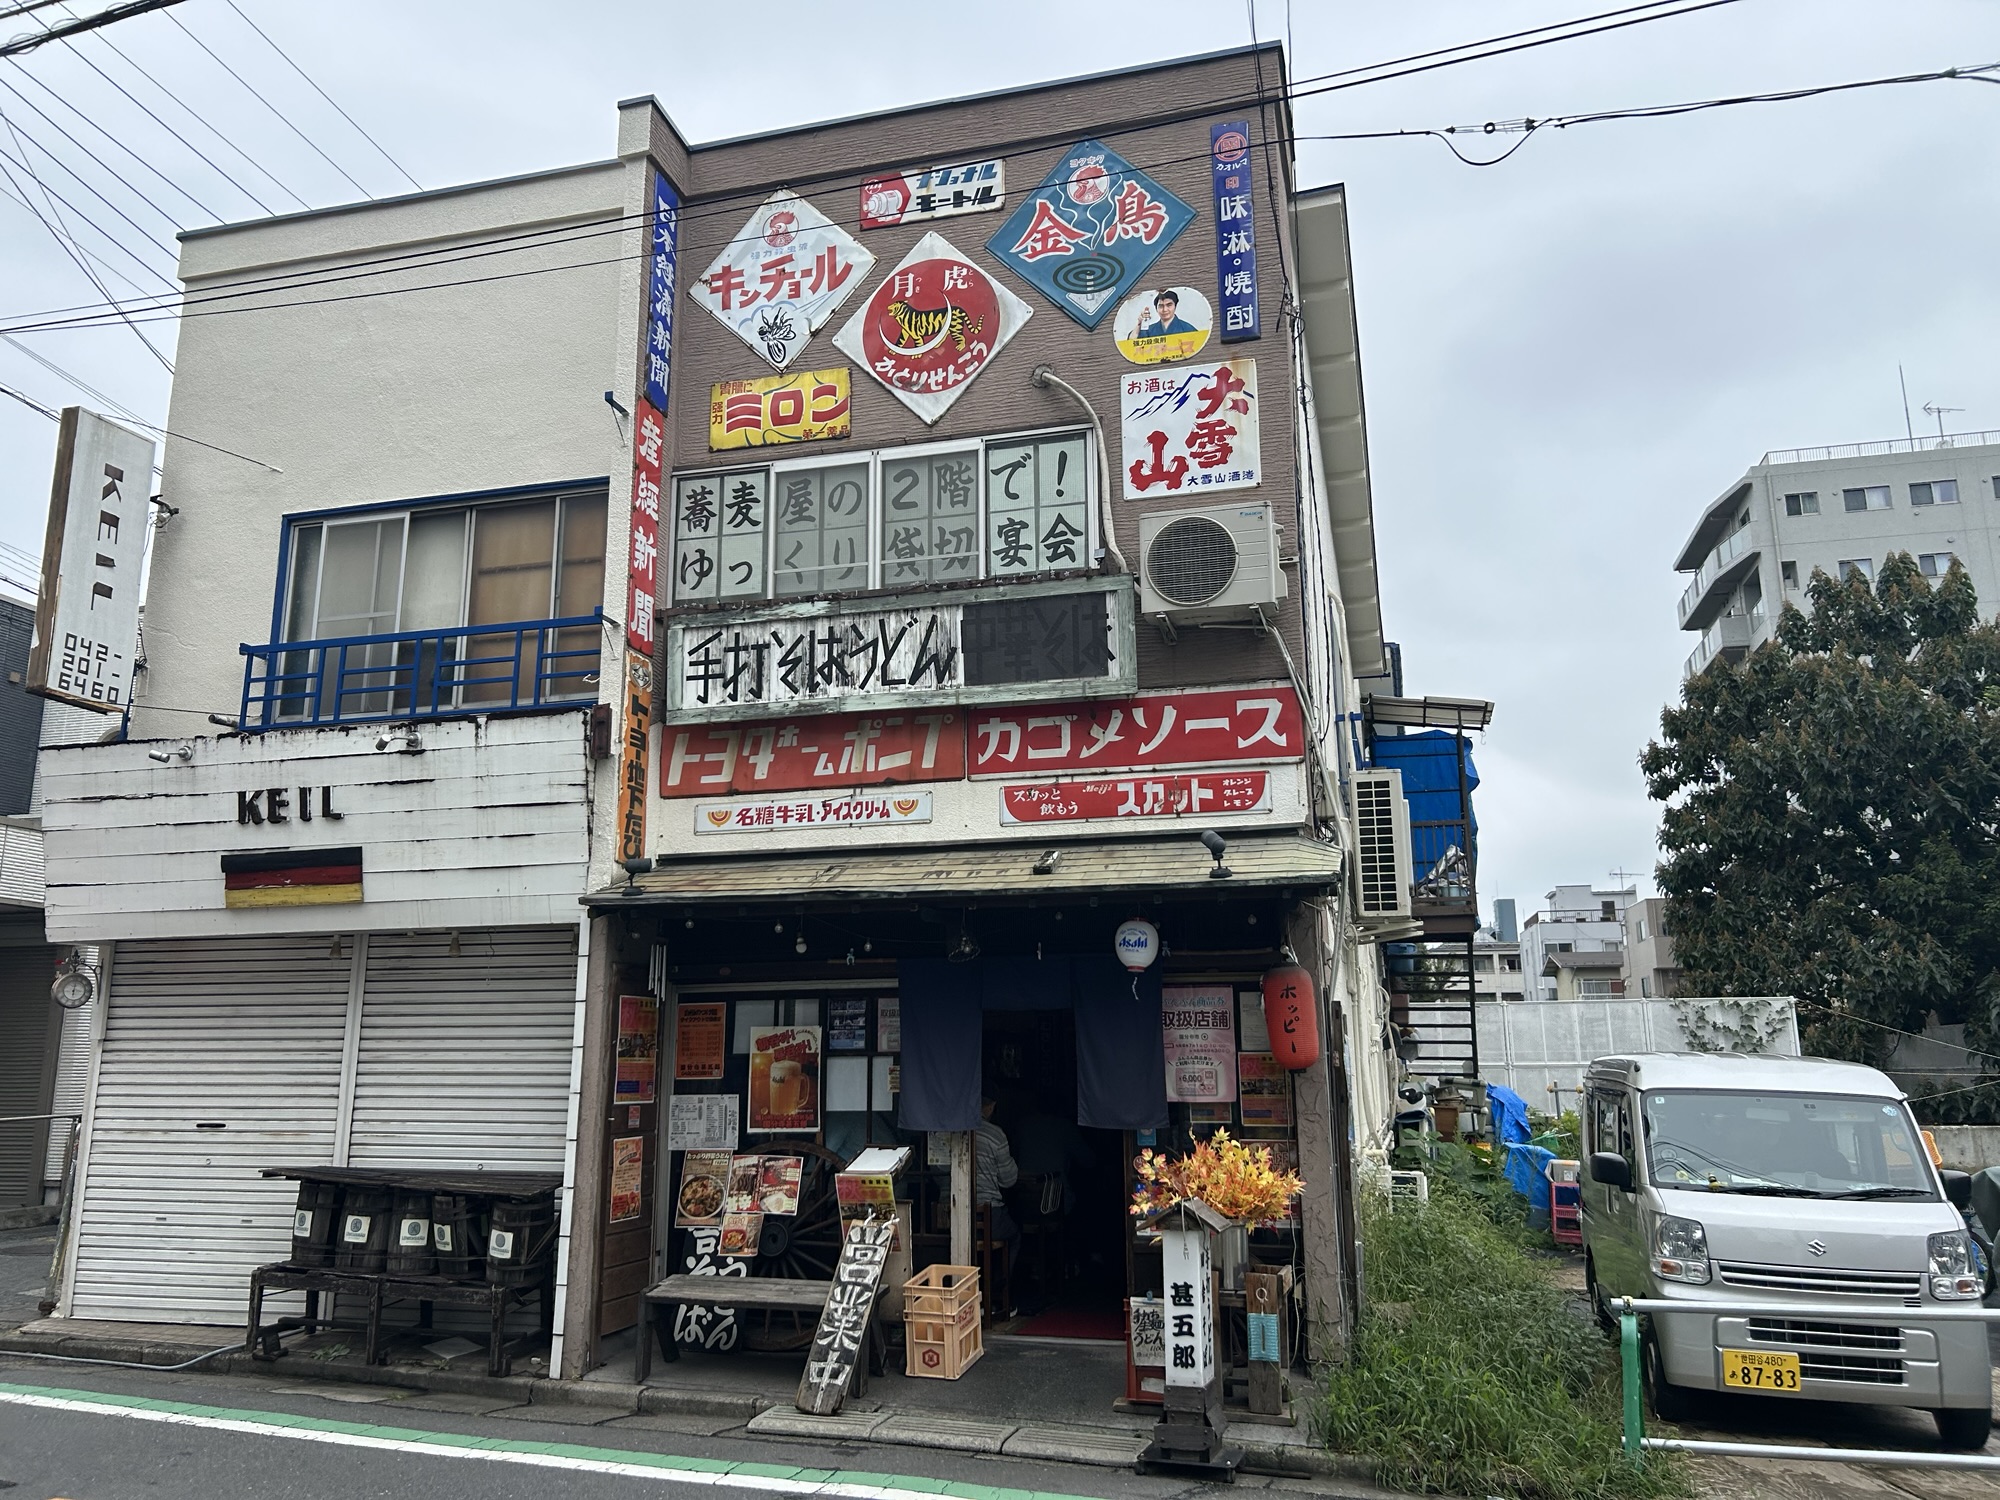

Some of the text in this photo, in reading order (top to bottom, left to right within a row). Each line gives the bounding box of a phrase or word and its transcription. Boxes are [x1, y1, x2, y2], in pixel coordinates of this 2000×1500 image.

[916, 163, 998, 189] ナショナル
[916, 185, 998, 213] モートル
[1009, 180, 1169, 262] 金鳥
[709, 244, 854, 311] キンチョール
[875, 340, 988, 391] かとりせんこう
[1127, 376, 1175, 395] お酒は
[725, 384, 849, 434] ミロン
[1187, 470, 1255, 486] 大雪山酒造
[91, 463, 124, 610] KEIL
[686, 614, 958, 704] 手打そばうどん
[58, 671, 119, 704] 6460
[977, 698, 1287, 765] カゴメソース
[624, 694, 649, 859] トーヨー地下たび
[1222, 777, 1252, 786] オレンジ
[238, 785, 344, 824] KEIL
[1013, 788, 1061, 802] スカッと
[1040, 801, 1078, 816] 飲もう
[1117, 778, 1214, 816] スカット
[1223, 799, 1253, 807] レモン
[1119, 936, 1148, 948] Asahi
[1162, 1010, 1229, 1028] 取扱店舗
[1279, 983, 1300, 1054] ホッピー
[809, 1226, 893, 1412] 営業中
[1170, 1281, 1195, 1369] 甚五郎
[1134, 1330, 1163, 1347] うどん
[1741, 1366, 1797, 1389] 87-83
